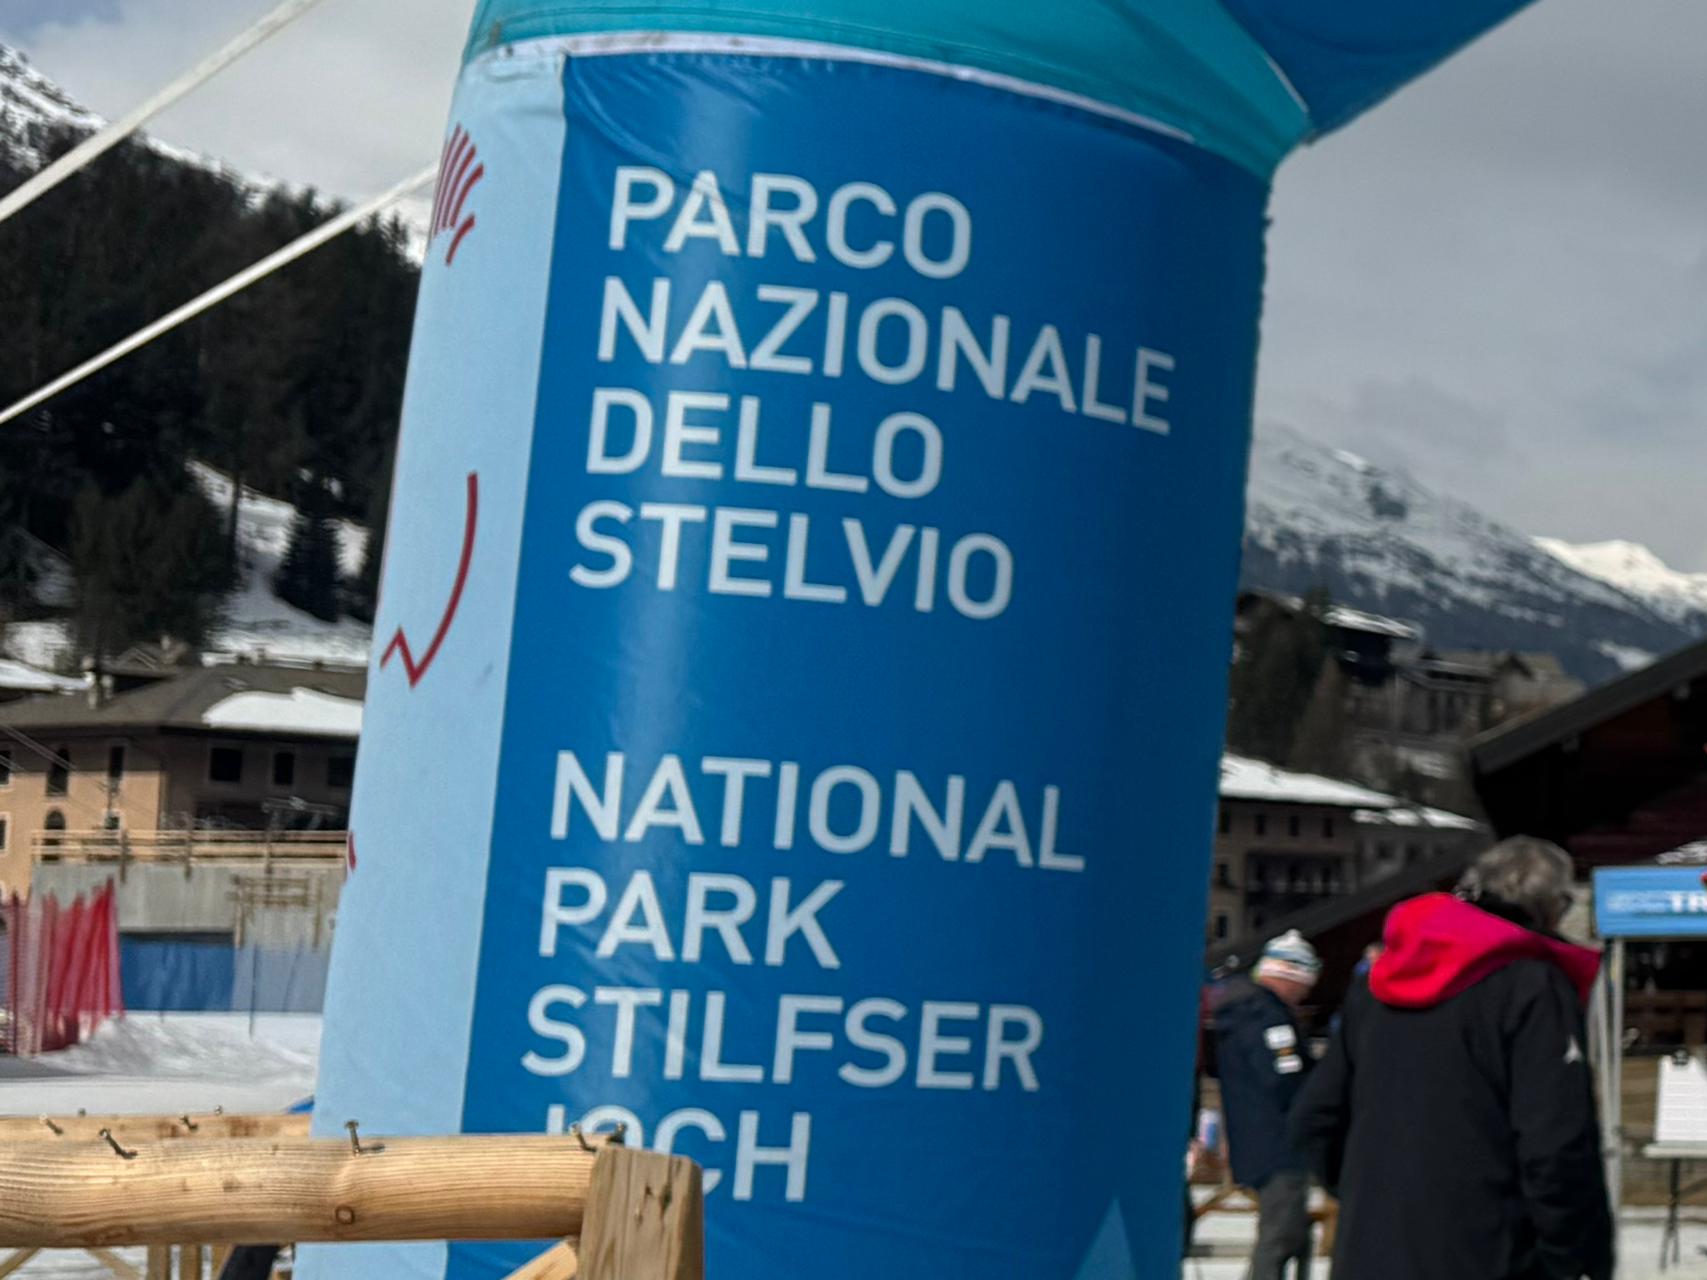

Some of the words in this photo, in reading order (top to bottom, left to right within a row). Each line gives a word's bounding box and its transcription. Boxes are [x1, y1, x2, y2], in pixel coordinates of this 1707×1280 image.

[607, 164, 972, 279] PARCO
[598, 275, 1175, 436] NAZIONALE
[586, 387, 943, 499] DELLO
[569, 500, 1014, 619] STELVIO
[549, 750, 1085, 873] NATIONAL
[540, 866, 845, 971] PARK
[521, 984, 1043, 1094] STILFSER
